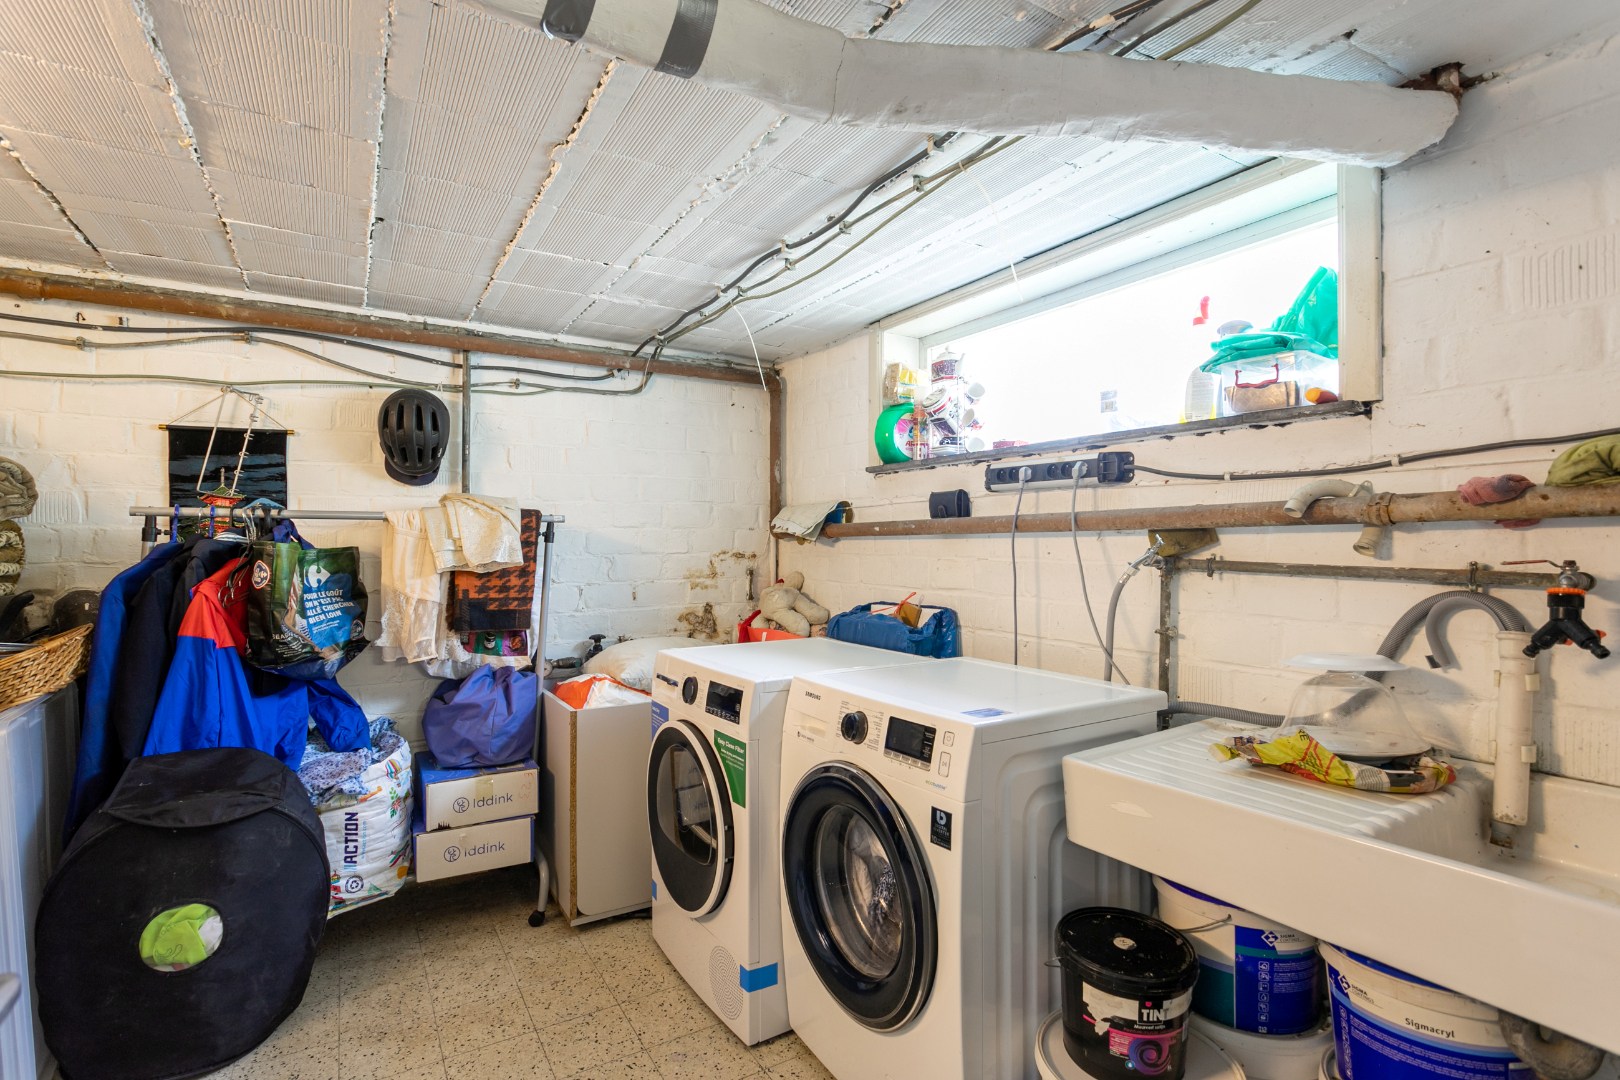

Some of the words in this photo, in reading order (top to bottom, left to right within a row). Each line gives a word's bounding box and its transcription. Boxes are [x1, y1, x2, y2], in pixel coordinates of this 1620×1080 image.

[306, 606, 322, 616] ALLÉ
[308, 614, 326, 624] BIEN
[326, 610, 342, 618] LOIN
[344, 812, 358, 864] ACTION
[1141, 1008, 1170, 1022] TINT
[1405, 1017, 1455, 1038] Sigmacryl
